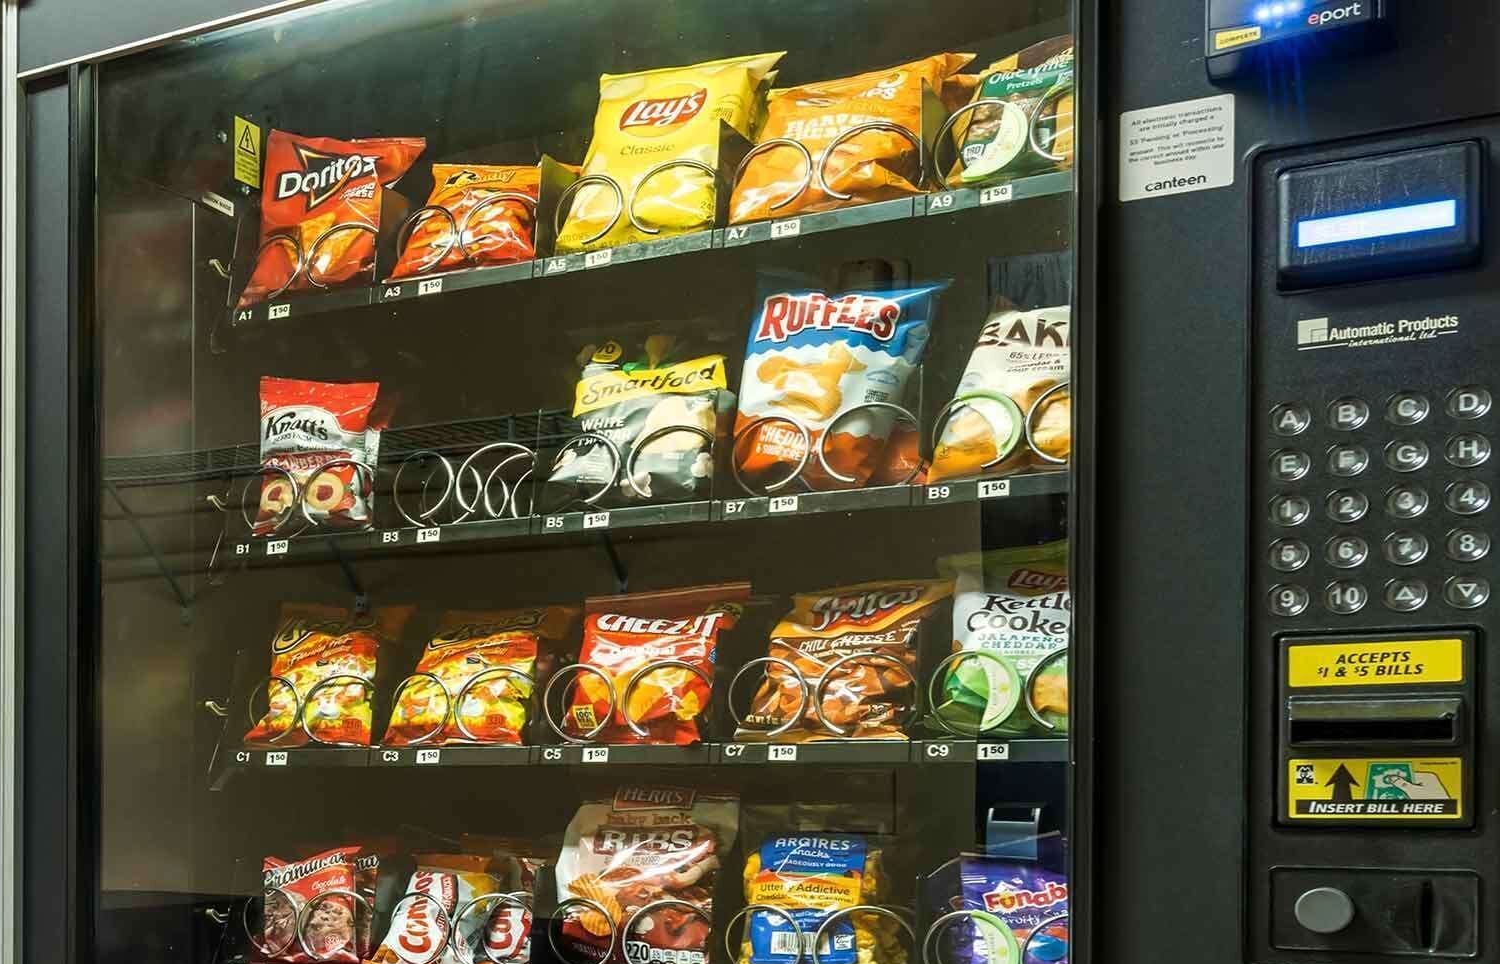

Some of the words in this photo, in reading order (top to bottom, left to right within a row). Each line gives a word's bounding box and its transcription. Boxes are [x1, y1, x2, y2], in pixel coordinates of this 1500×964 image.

[1307, 3, 1362, 25] eport
[619, 143, 676, 156] Classic
[278, 155, 381, 199] Doritos
[1145, 174, 1207, 192] canteen
[930, 194, 954, 210] A9
[728, 228, 749, 241] A7
[547, 260, 567, 272] A5
[384, 287, 401, 298] A3
[238, 311, 253, 321] A1
[757, 294, 900, 341] RUFFLES
[1329, 321, 1395, 341] Automatic
[1398, 315, 1459, 334] Products
[581, 364, 716, 405] Smartfood
[1279, 409, 1299, 428] A
[1337, 405, 1357, 423] B
[1397, 398, 1417, 417] C
[1459, 393, 1479, 412] D
[265, 411, 329, 441] Knott's
[1280, 455, 1298, 473] E
[1338, 450, 1356, 468] F
[1396, 445, 1418, 463] G
[1458, 440, 1478, 458] H
[928, 487, 950, 499] B9
[725, 501, 746, 513] B7
[1281, 500, 1292, 517] 1
[1339, 496, 1354, 513] 2
[1398, 491, 1414, 510] 3
[1459, 487, 1477, 505] 4
[546, 517, 564, 528] B5
[383, 532, 399, 542] B3
[236, 544, 250, 554] B1
[1281, 545, 1296, 562] 5
[1338, 541, 1354, 559] 6
[1398, 537, 1413, 555] 7
[1459, 534, 1475, 552] 8
[1280, 590, 1295, 607] 9
[1331, 587, 1359, 605] 10
[799, 640, 828, 653] CHILI
[1335, 651, 1411, 665] ACCEPTS
[1334, 666, 1347, 677] &
[1375, 663, 1424, 676] BILLS
[236, 751, 250, 762] C1
[382, 751, 399, 761] C3
[543, 748, 562, 760] C5
[725, 745, 745, 756] C7
[927, 744, 949, 757] C9
[1308, 801, 1364, 814] INSERT
[1366, 803, 1399, 814] BILL
[1402, 803, 1444, 814] HERE
[601, 830, 694, 850] RIBS
[796, 883, 851, 895] Addictive
